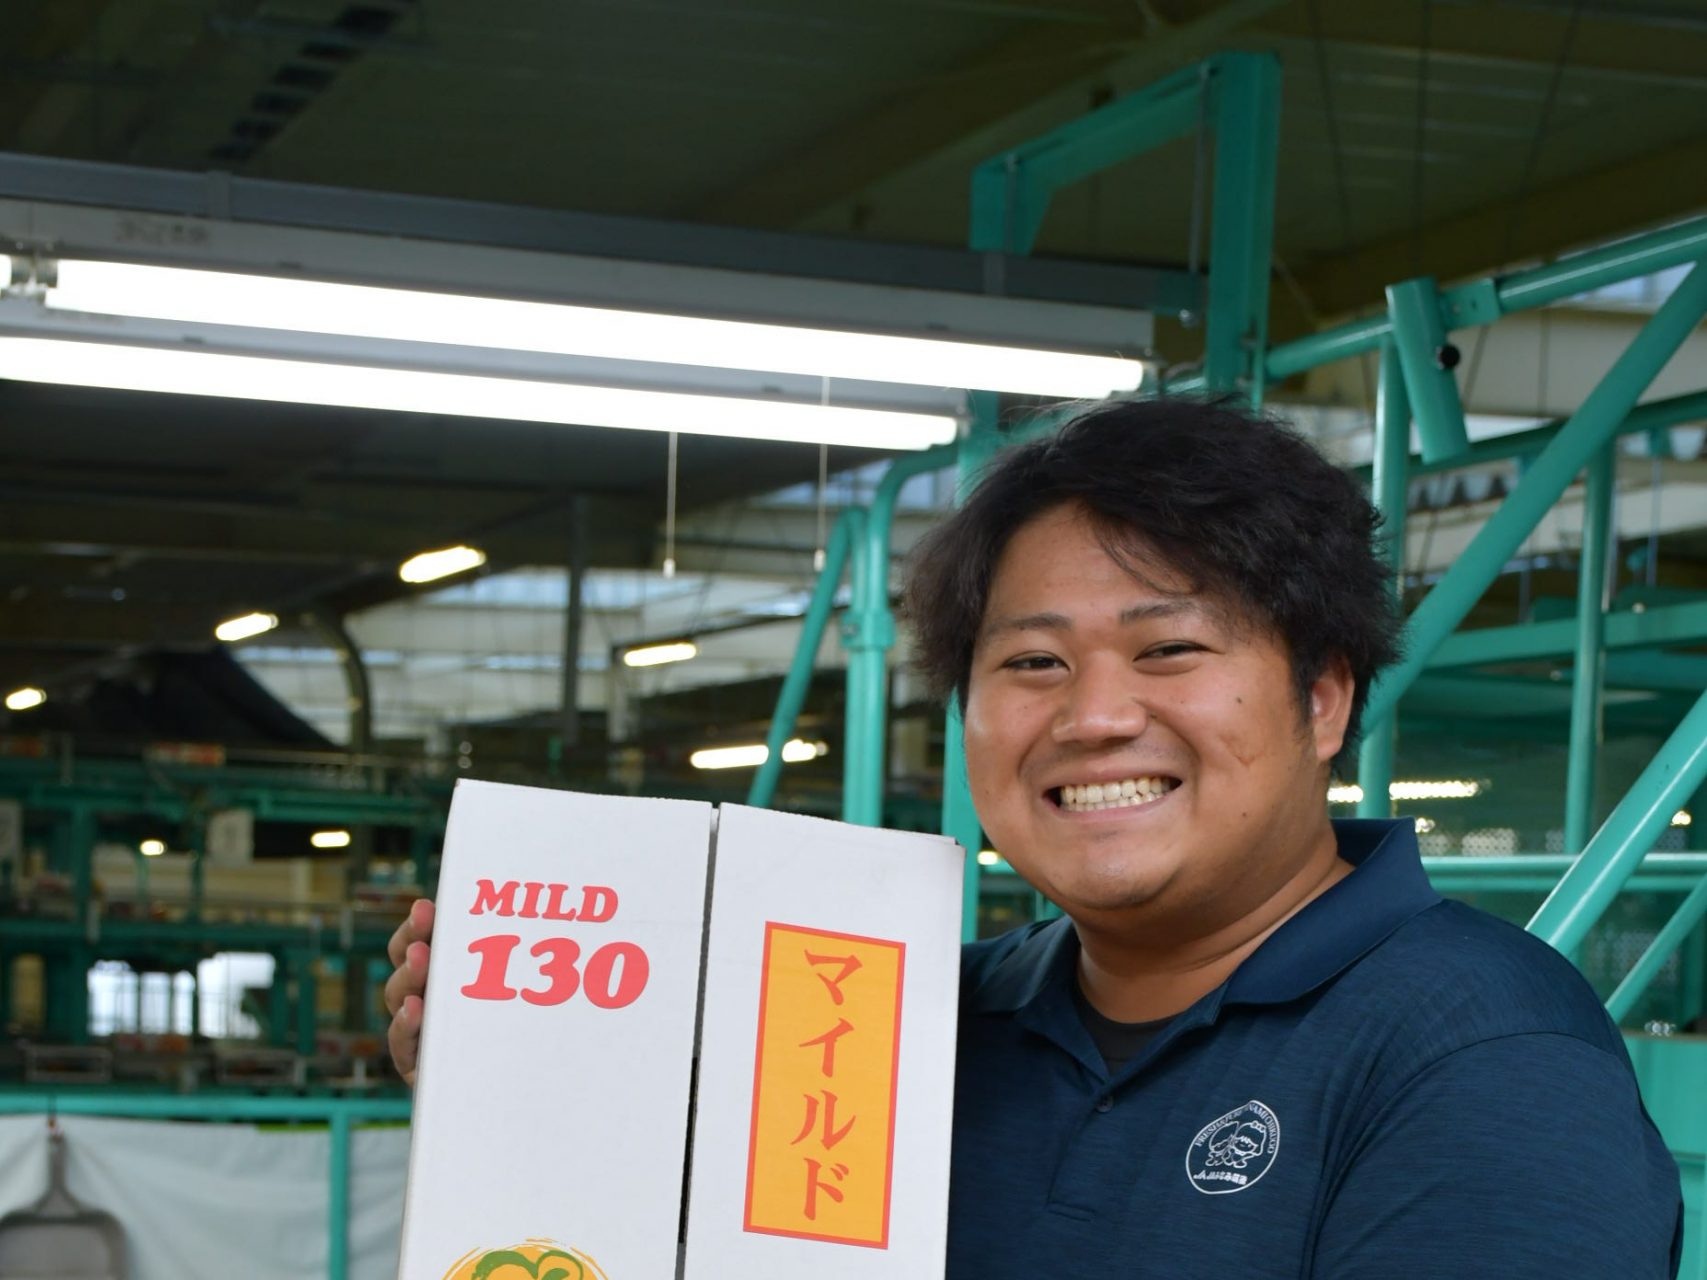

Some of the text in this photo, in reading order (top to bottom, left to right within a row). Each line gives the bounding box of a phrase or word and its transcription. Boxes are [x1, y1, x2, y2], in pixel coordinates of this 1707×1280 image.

[469, 879, 618, 923] MILD
[460, 934, 650, 1010] 130
[789, 948, 864, 1222] マイルド
